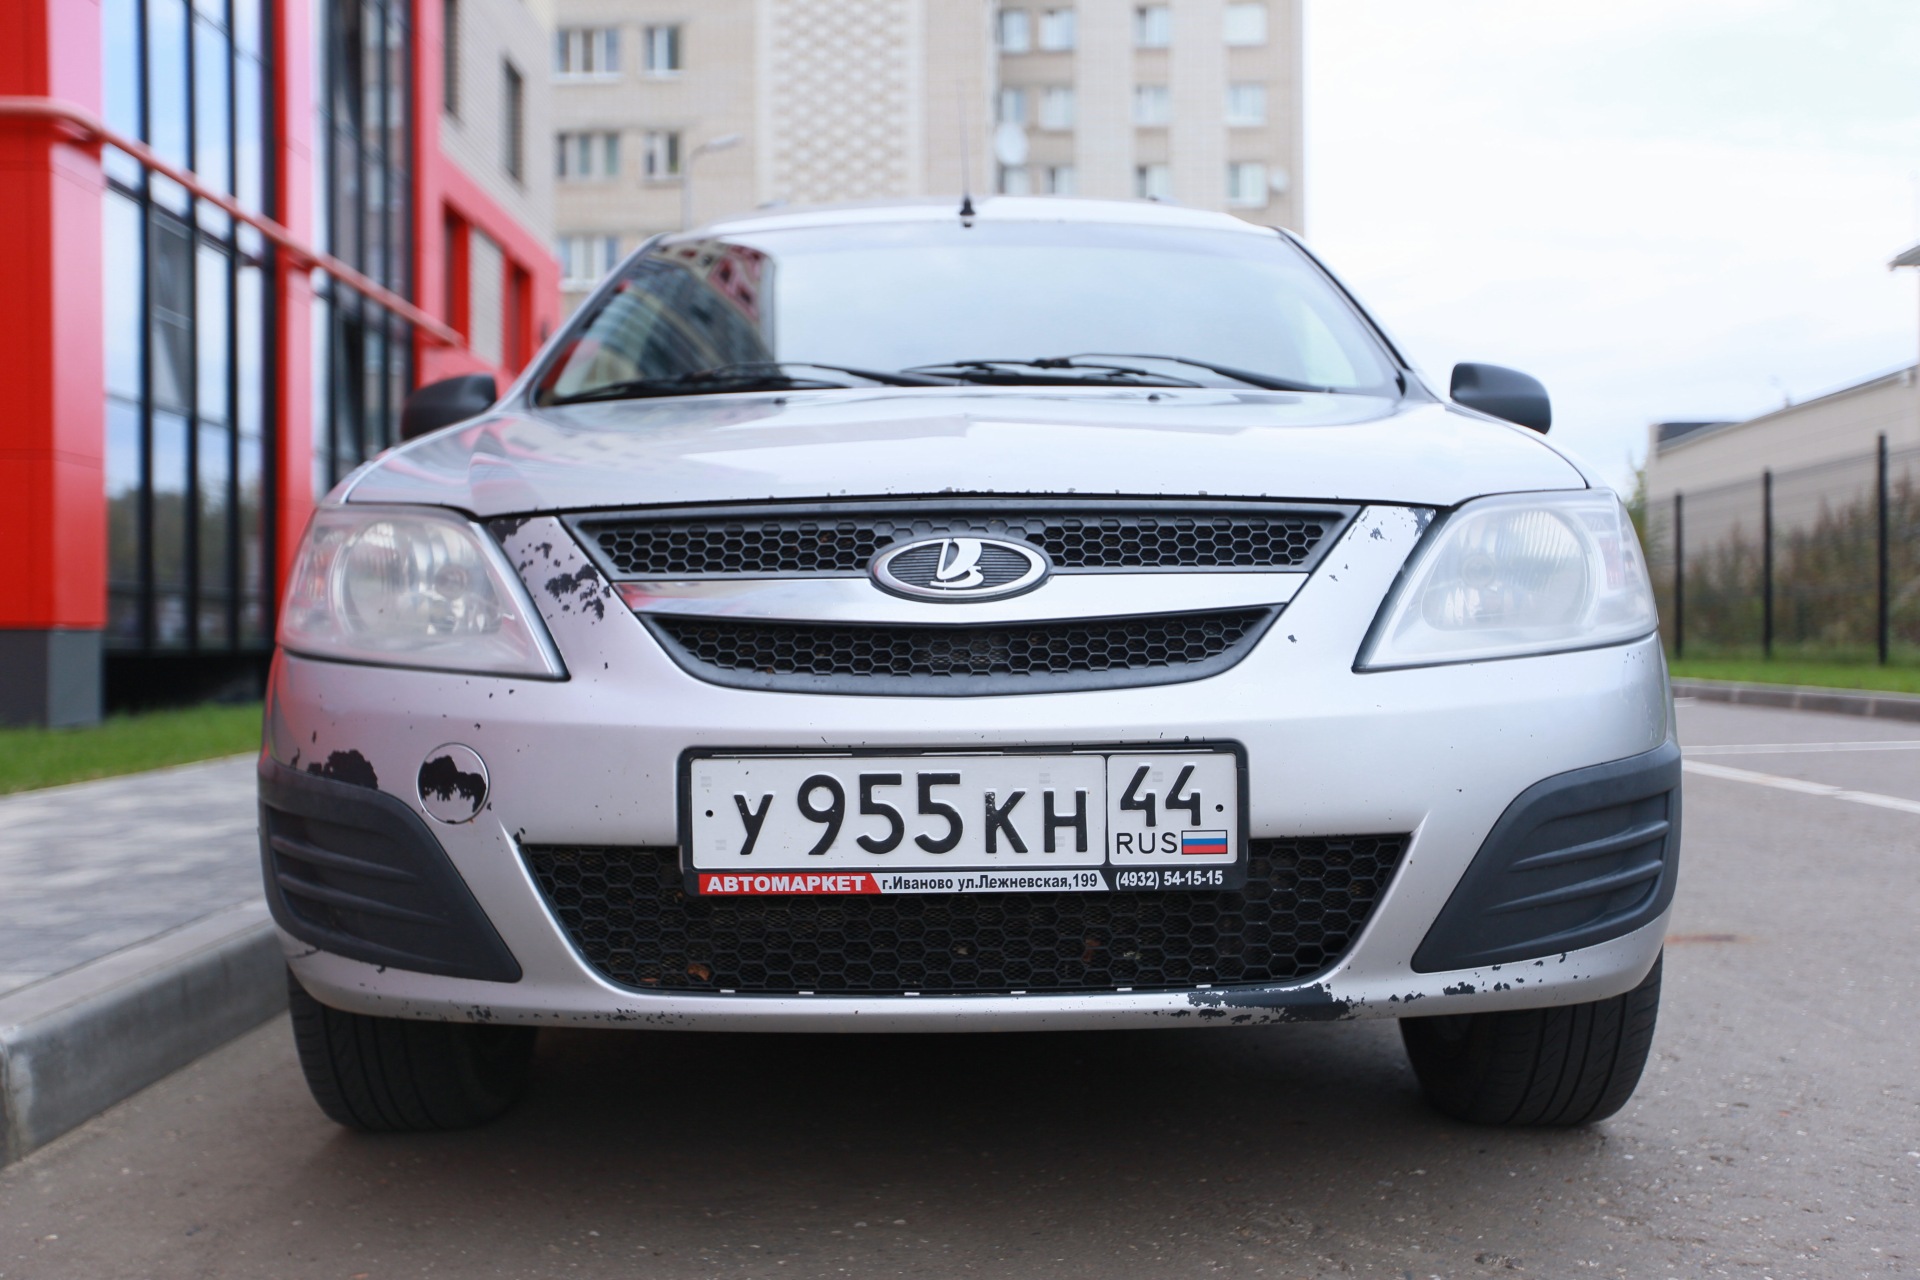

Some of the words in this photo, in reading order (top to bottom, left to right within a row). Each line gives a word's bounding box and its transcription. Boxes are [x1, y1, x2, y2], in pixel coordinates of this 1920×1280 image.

[1120, 765, 1201, 827] 44
[1116, 832, 1178, 854] RUS
[707, 876, 866, 892] АВТОМАРКЕТ
[882, 875, 953, 890] г.Иваново
[1115, 871, 1160, 890] (4932)
[1163, 870, 1224, 886] 54-15-15
